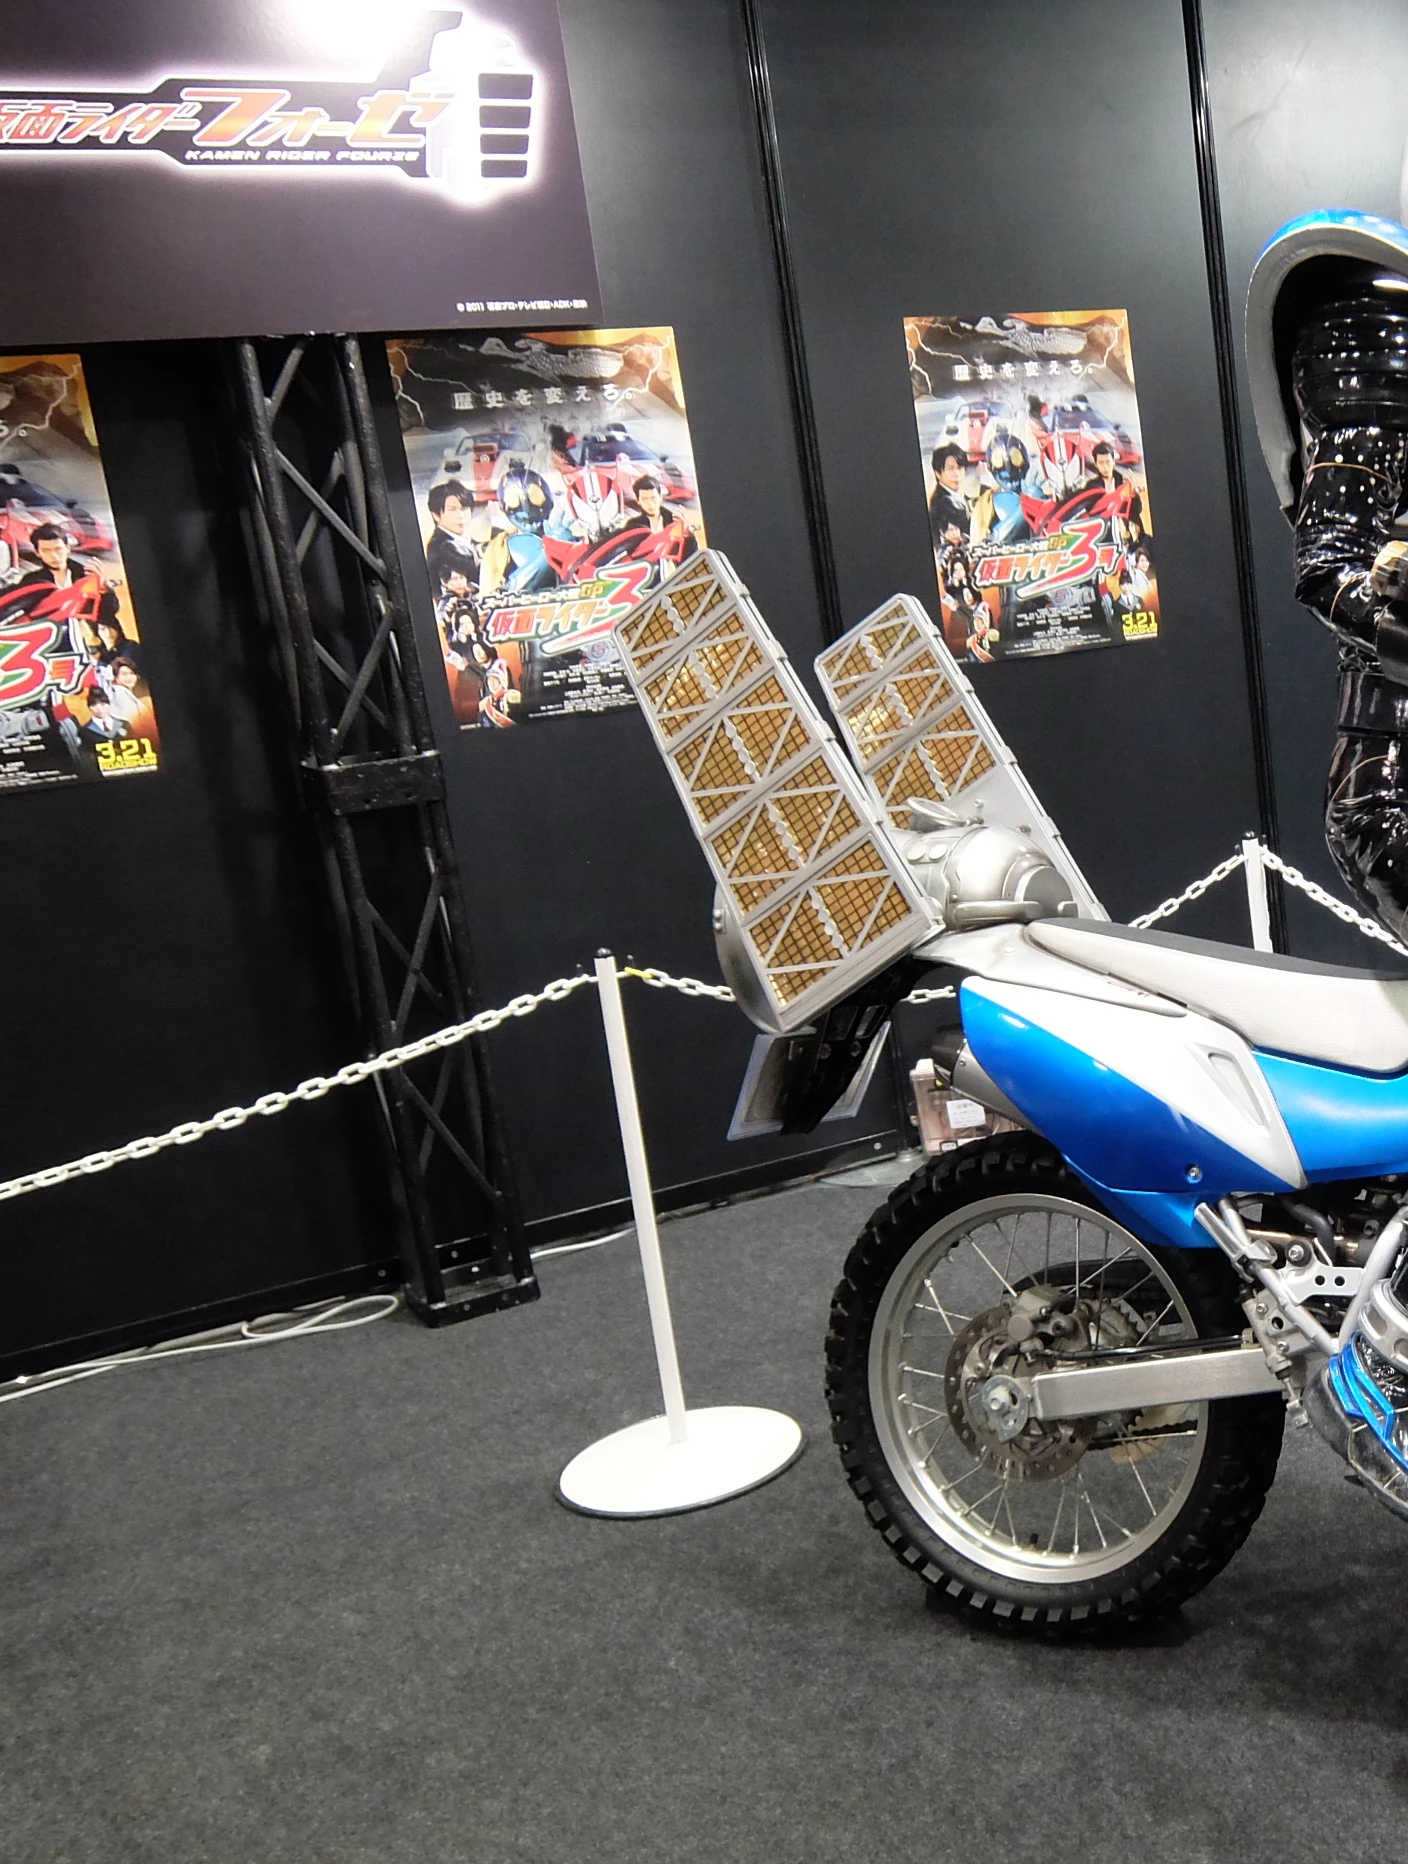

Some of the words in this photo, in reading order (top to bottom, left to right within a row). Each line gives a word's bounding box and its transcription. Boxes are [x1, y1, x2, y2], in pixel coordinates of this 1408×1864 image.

[185, 150, 260, 161] KAMEN
[265, 150, 331, 161] RIDER
[335, 150, 419, 162] FOURZE
[953, 359, 1095, 381] 歴史を変えろ。
[453, 383, 635, 410] 歴史を変えろ。
[1122, 611, 1157, 630] 3.21
[95, 738, 156, 763] 3.21
